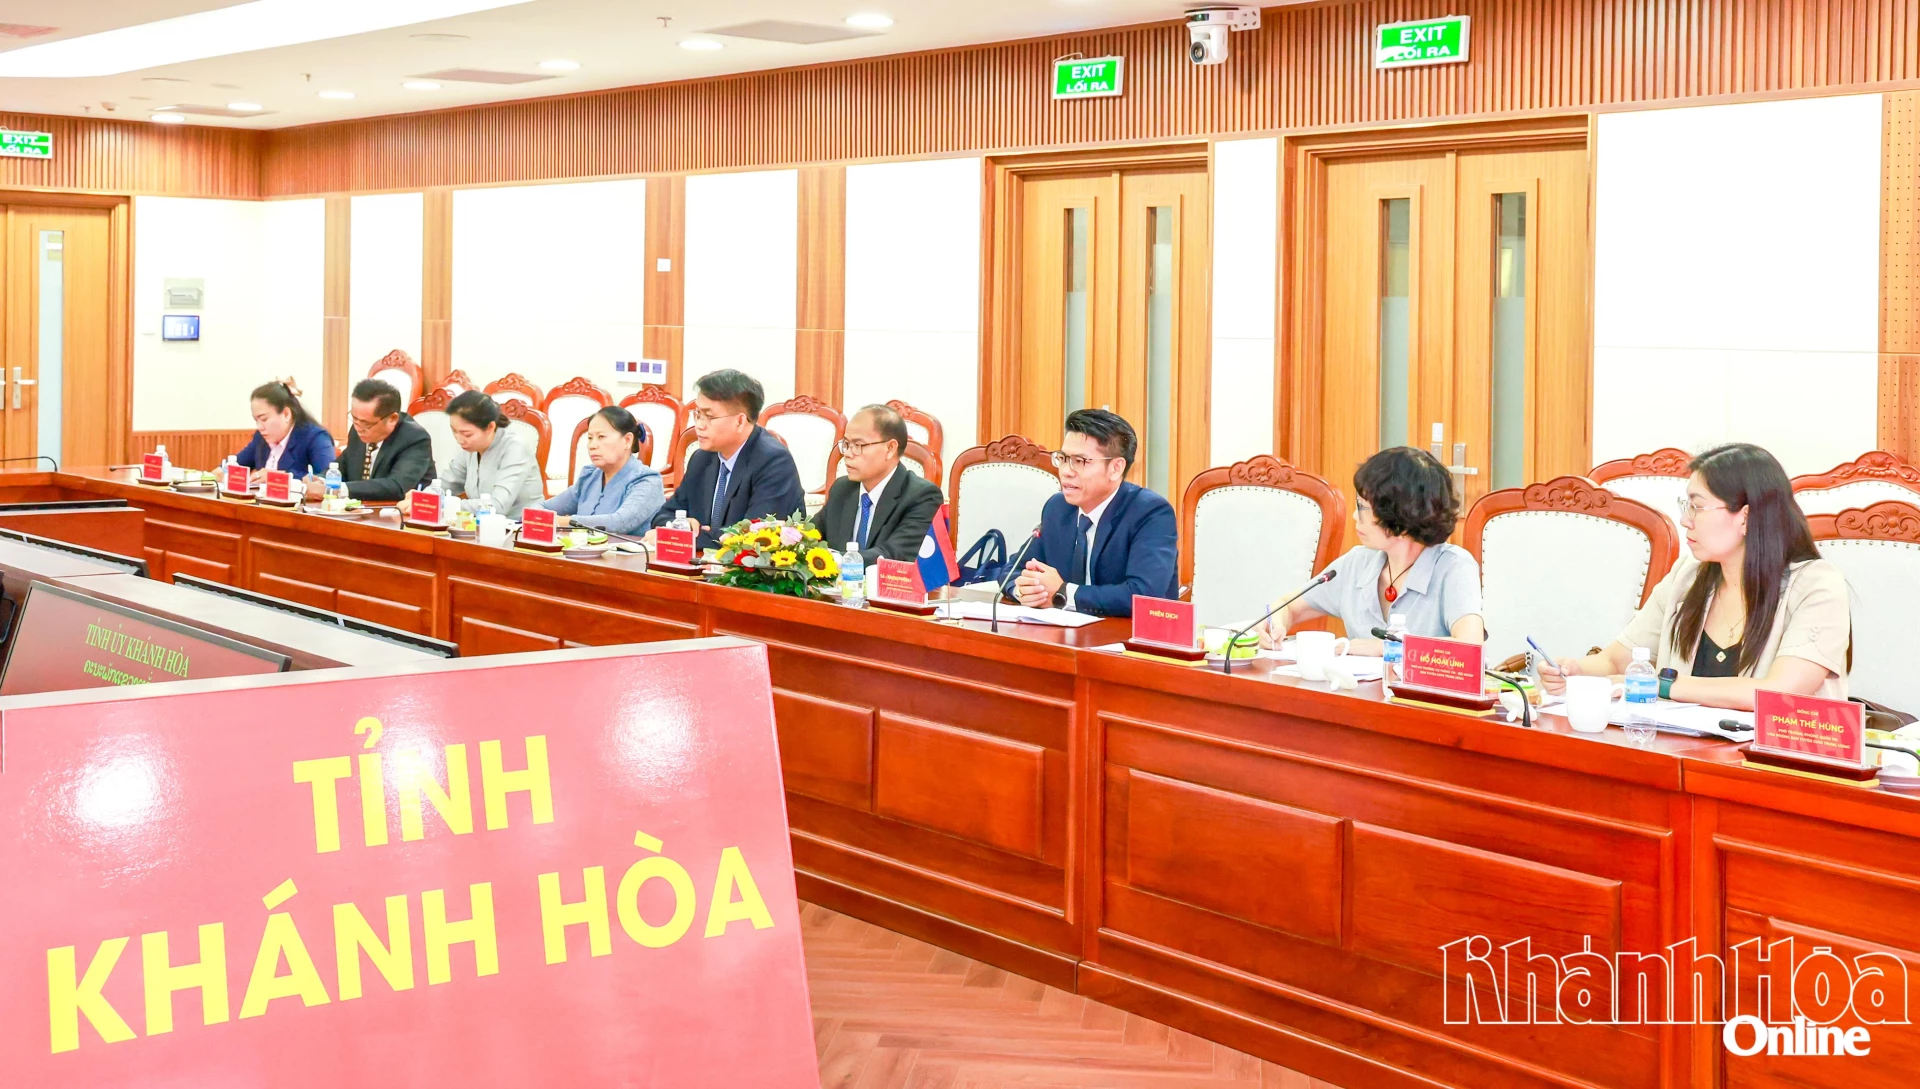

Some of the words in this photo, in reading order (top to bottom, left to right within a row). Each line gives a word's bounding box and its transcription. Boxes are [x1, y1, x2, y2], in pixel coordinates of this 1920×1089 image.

[1400, 25, 1447, 44] EXIT
[1426, 45, 1451, 57] RA
[1072, 63, 1106, 79] EXIT
[1066, 80, 1088, 93] LỐI
[1090, 80, 1109, 91] RA
[3, 133, 39, 145] EXIT
[124, 635, 167, 669] KHÁNH
[163, 646, 190, 678] HÒA
[1772, 716, 1797, 726] PHẠM
[1800, 719, 1816, 728] THẾ
[1818, 722, 1844, 733] HÙNG
[293, 716, 554, 853] TỈNH
[47, 877, 499, 1053] KHÁNH
[538, 830, 775, 965] HÒA
